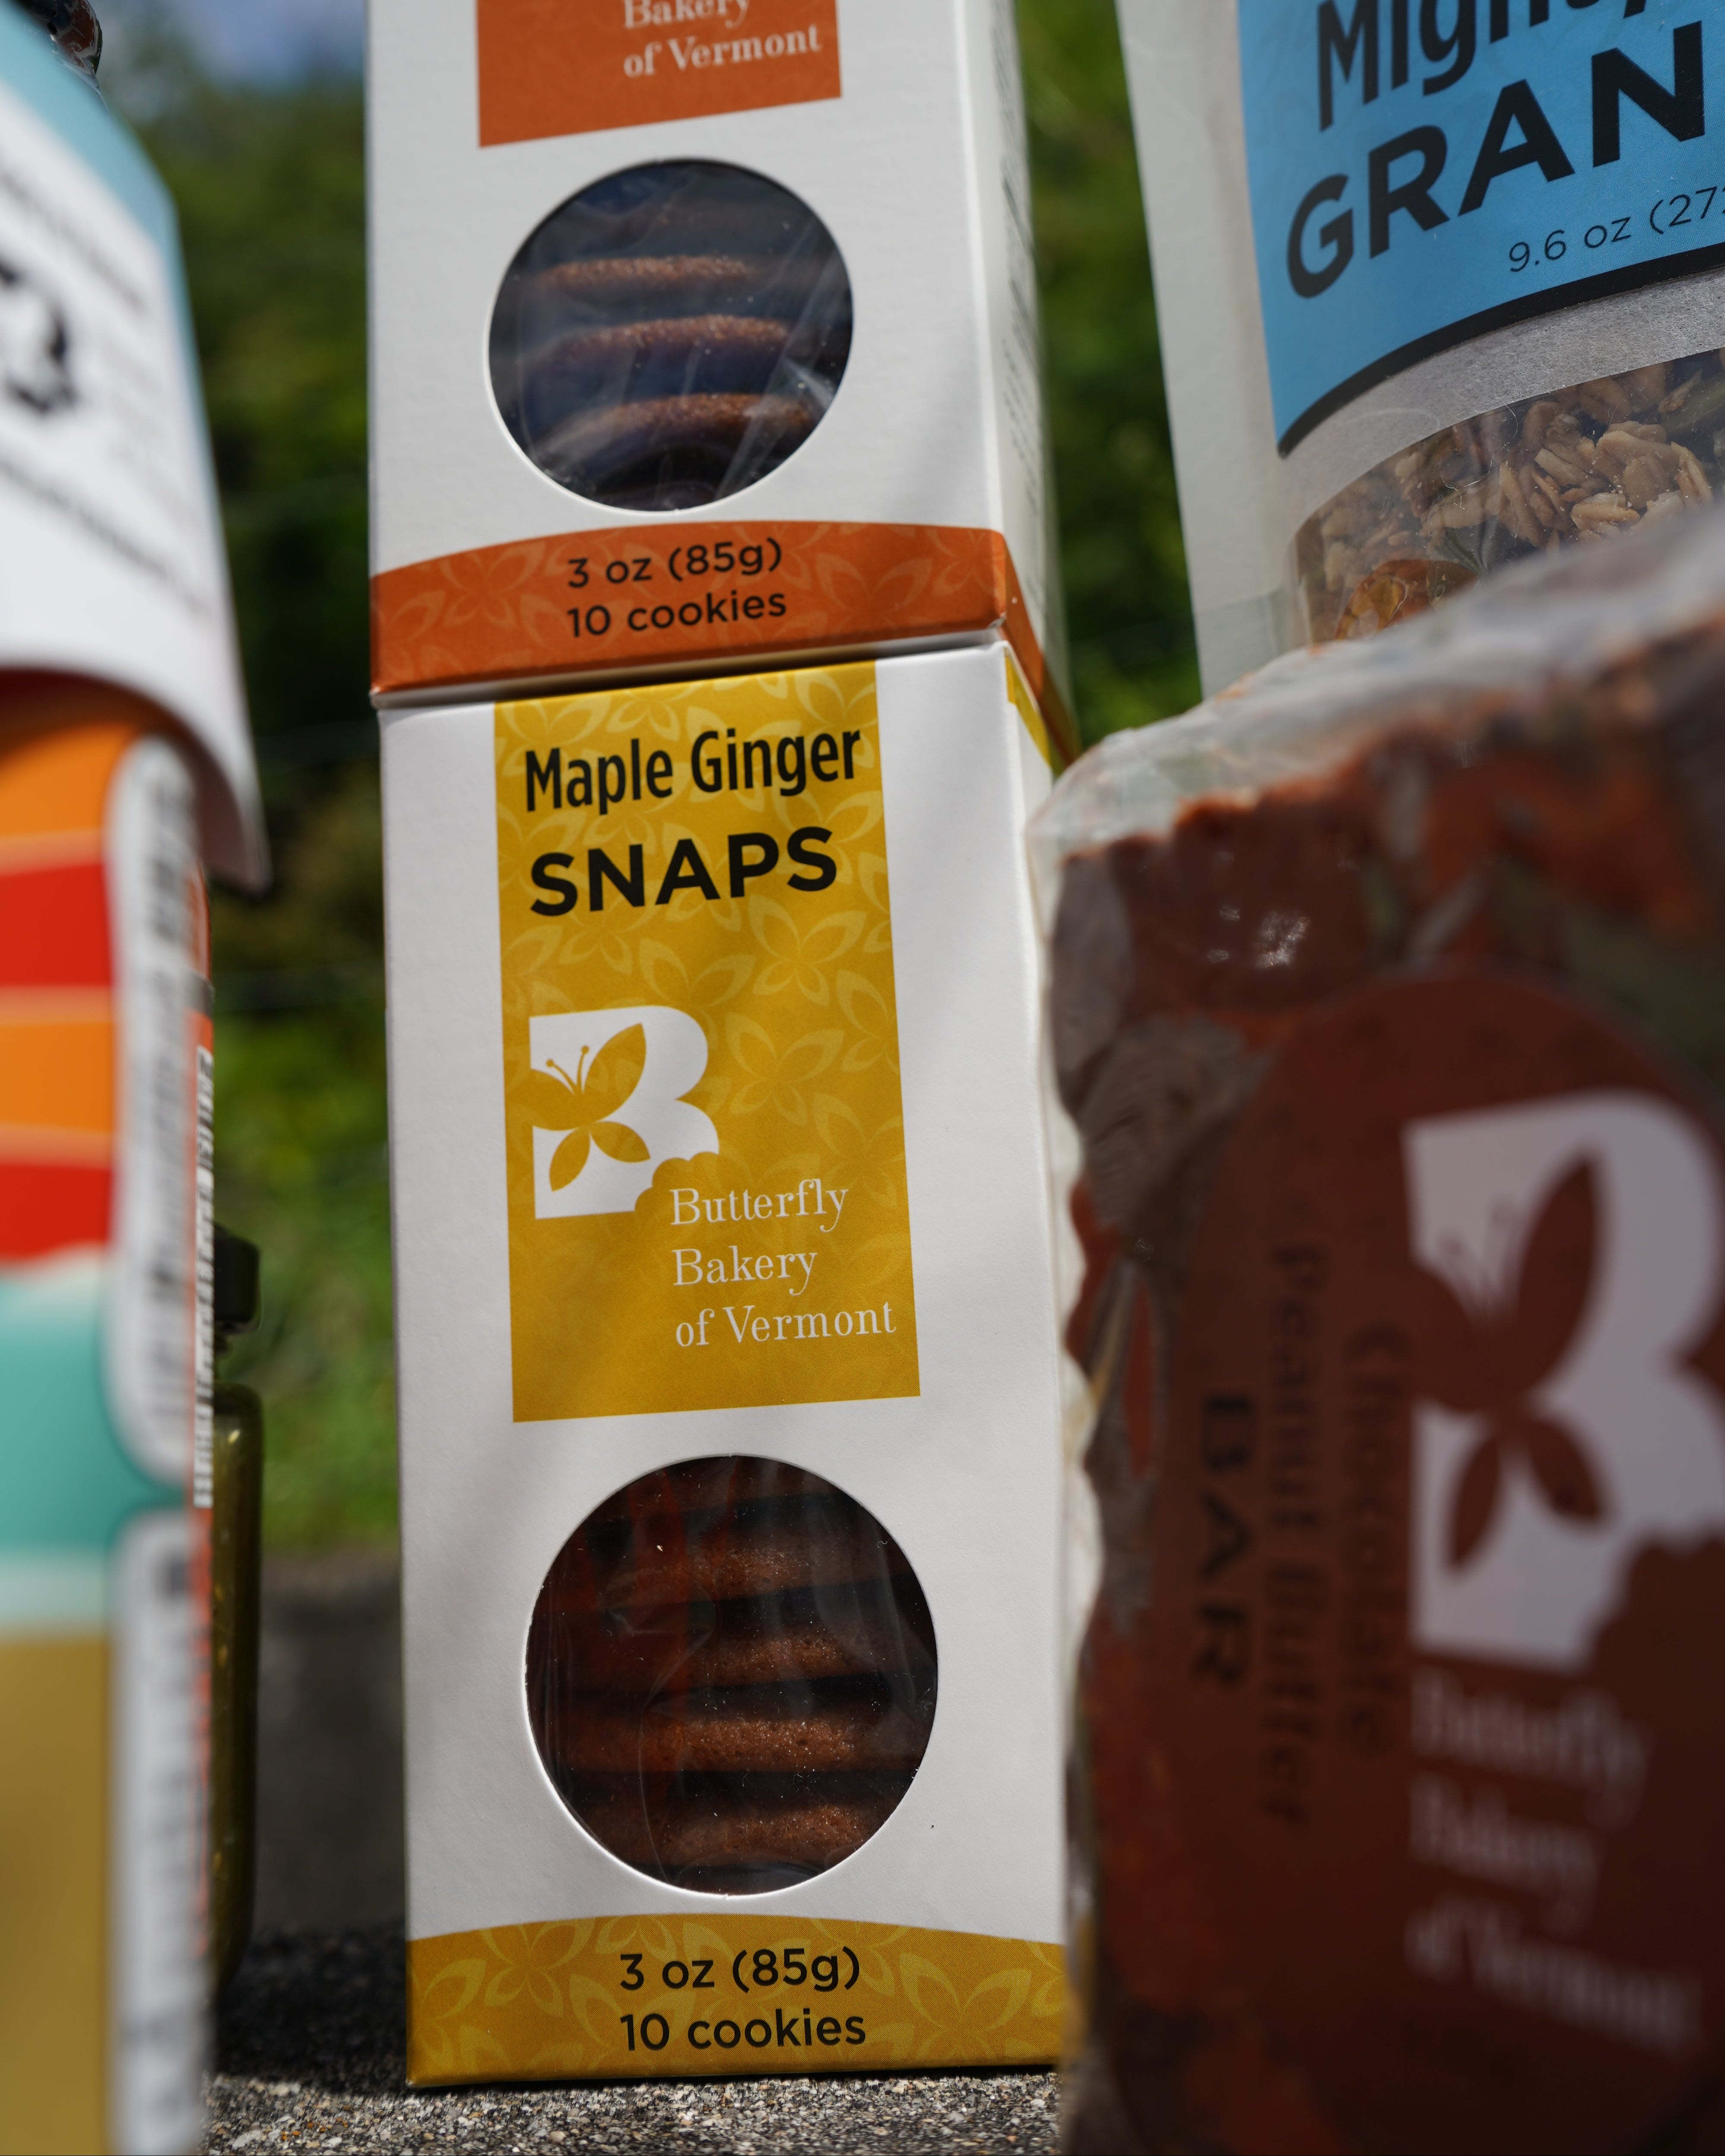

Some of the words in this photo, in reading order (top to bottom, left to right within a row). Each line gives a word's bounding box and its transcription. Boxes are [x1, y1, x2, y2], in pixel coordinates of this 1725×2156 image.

[624, 0, 750, 29] Bakery
[623, 41, 663, 78] of
[667, 24, 822, 71] Vermont
[1286, 20, 1705, 298] GRAN
[1509, 229, 1567, 273] 9.6
[1584, 216, 1631, 248] oz
[1650, 186, 1725, 235] (27
[568, 557, 590, 588] 3
[606, 557, 652, 583] oz
[668, 537, 782, 582] (85g)
[567, 605, 611, 637] 10
[627, 590, 787, 631] cookies
[526, 738, 673, 815] Maple
[692, 728, 860, 796] Ginger
[530, 826, 837, 917] SNAPS
[669, 1178, 848, 1232] Butterfly
[671, 1245, 818, 1296] Bakery
[675, 1309, 715, 1347] of
[722, 1302, 897, 1343] Vermont
[1192, 1392, 1254, 1692] BAR
[620, 1953, 644, 1990] 3
[662, 1960, 715, 1990] oz
[733, 1946, 859, 1993] (85g)
[620, 2013, 669, 2051] 10
[688, 2008, 866, 2049] cookies
